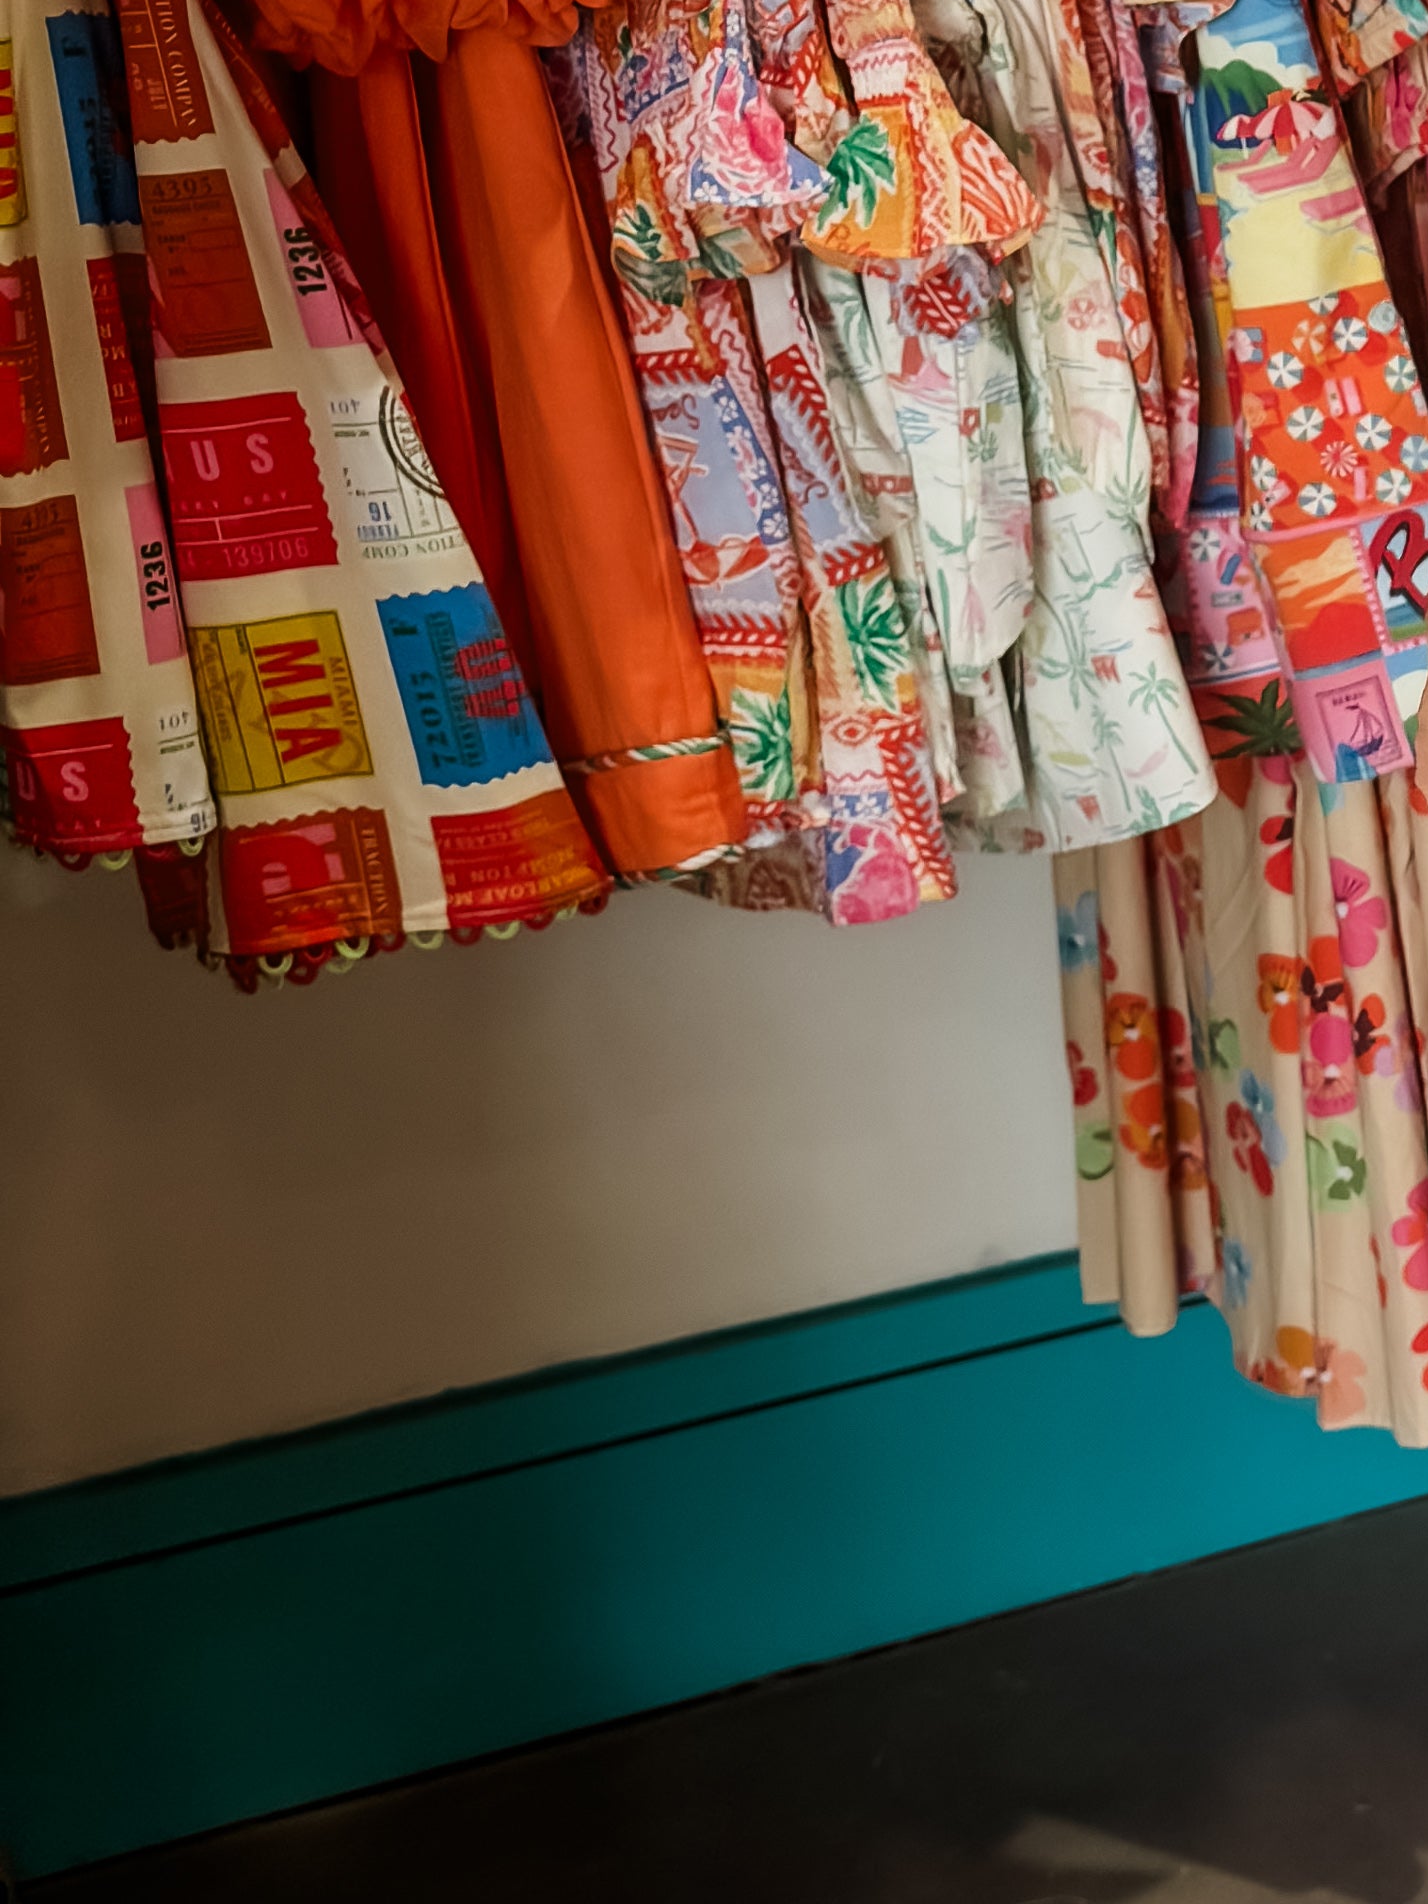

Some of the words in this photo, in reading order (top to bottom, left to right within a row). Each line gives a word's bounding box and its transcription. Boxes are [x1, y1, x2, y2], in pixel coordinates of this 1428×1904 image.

[283, 226, 328, 297] 1236
[368, 500, 392, 522] 16
[140, 540, 171, 611] 1236
[223, 537, 310, 568] 139706
[253, 638, 344, 765] MIA
[328, 655, 358, 727] MIAMI
[409, 671, 458, 769] 72015
